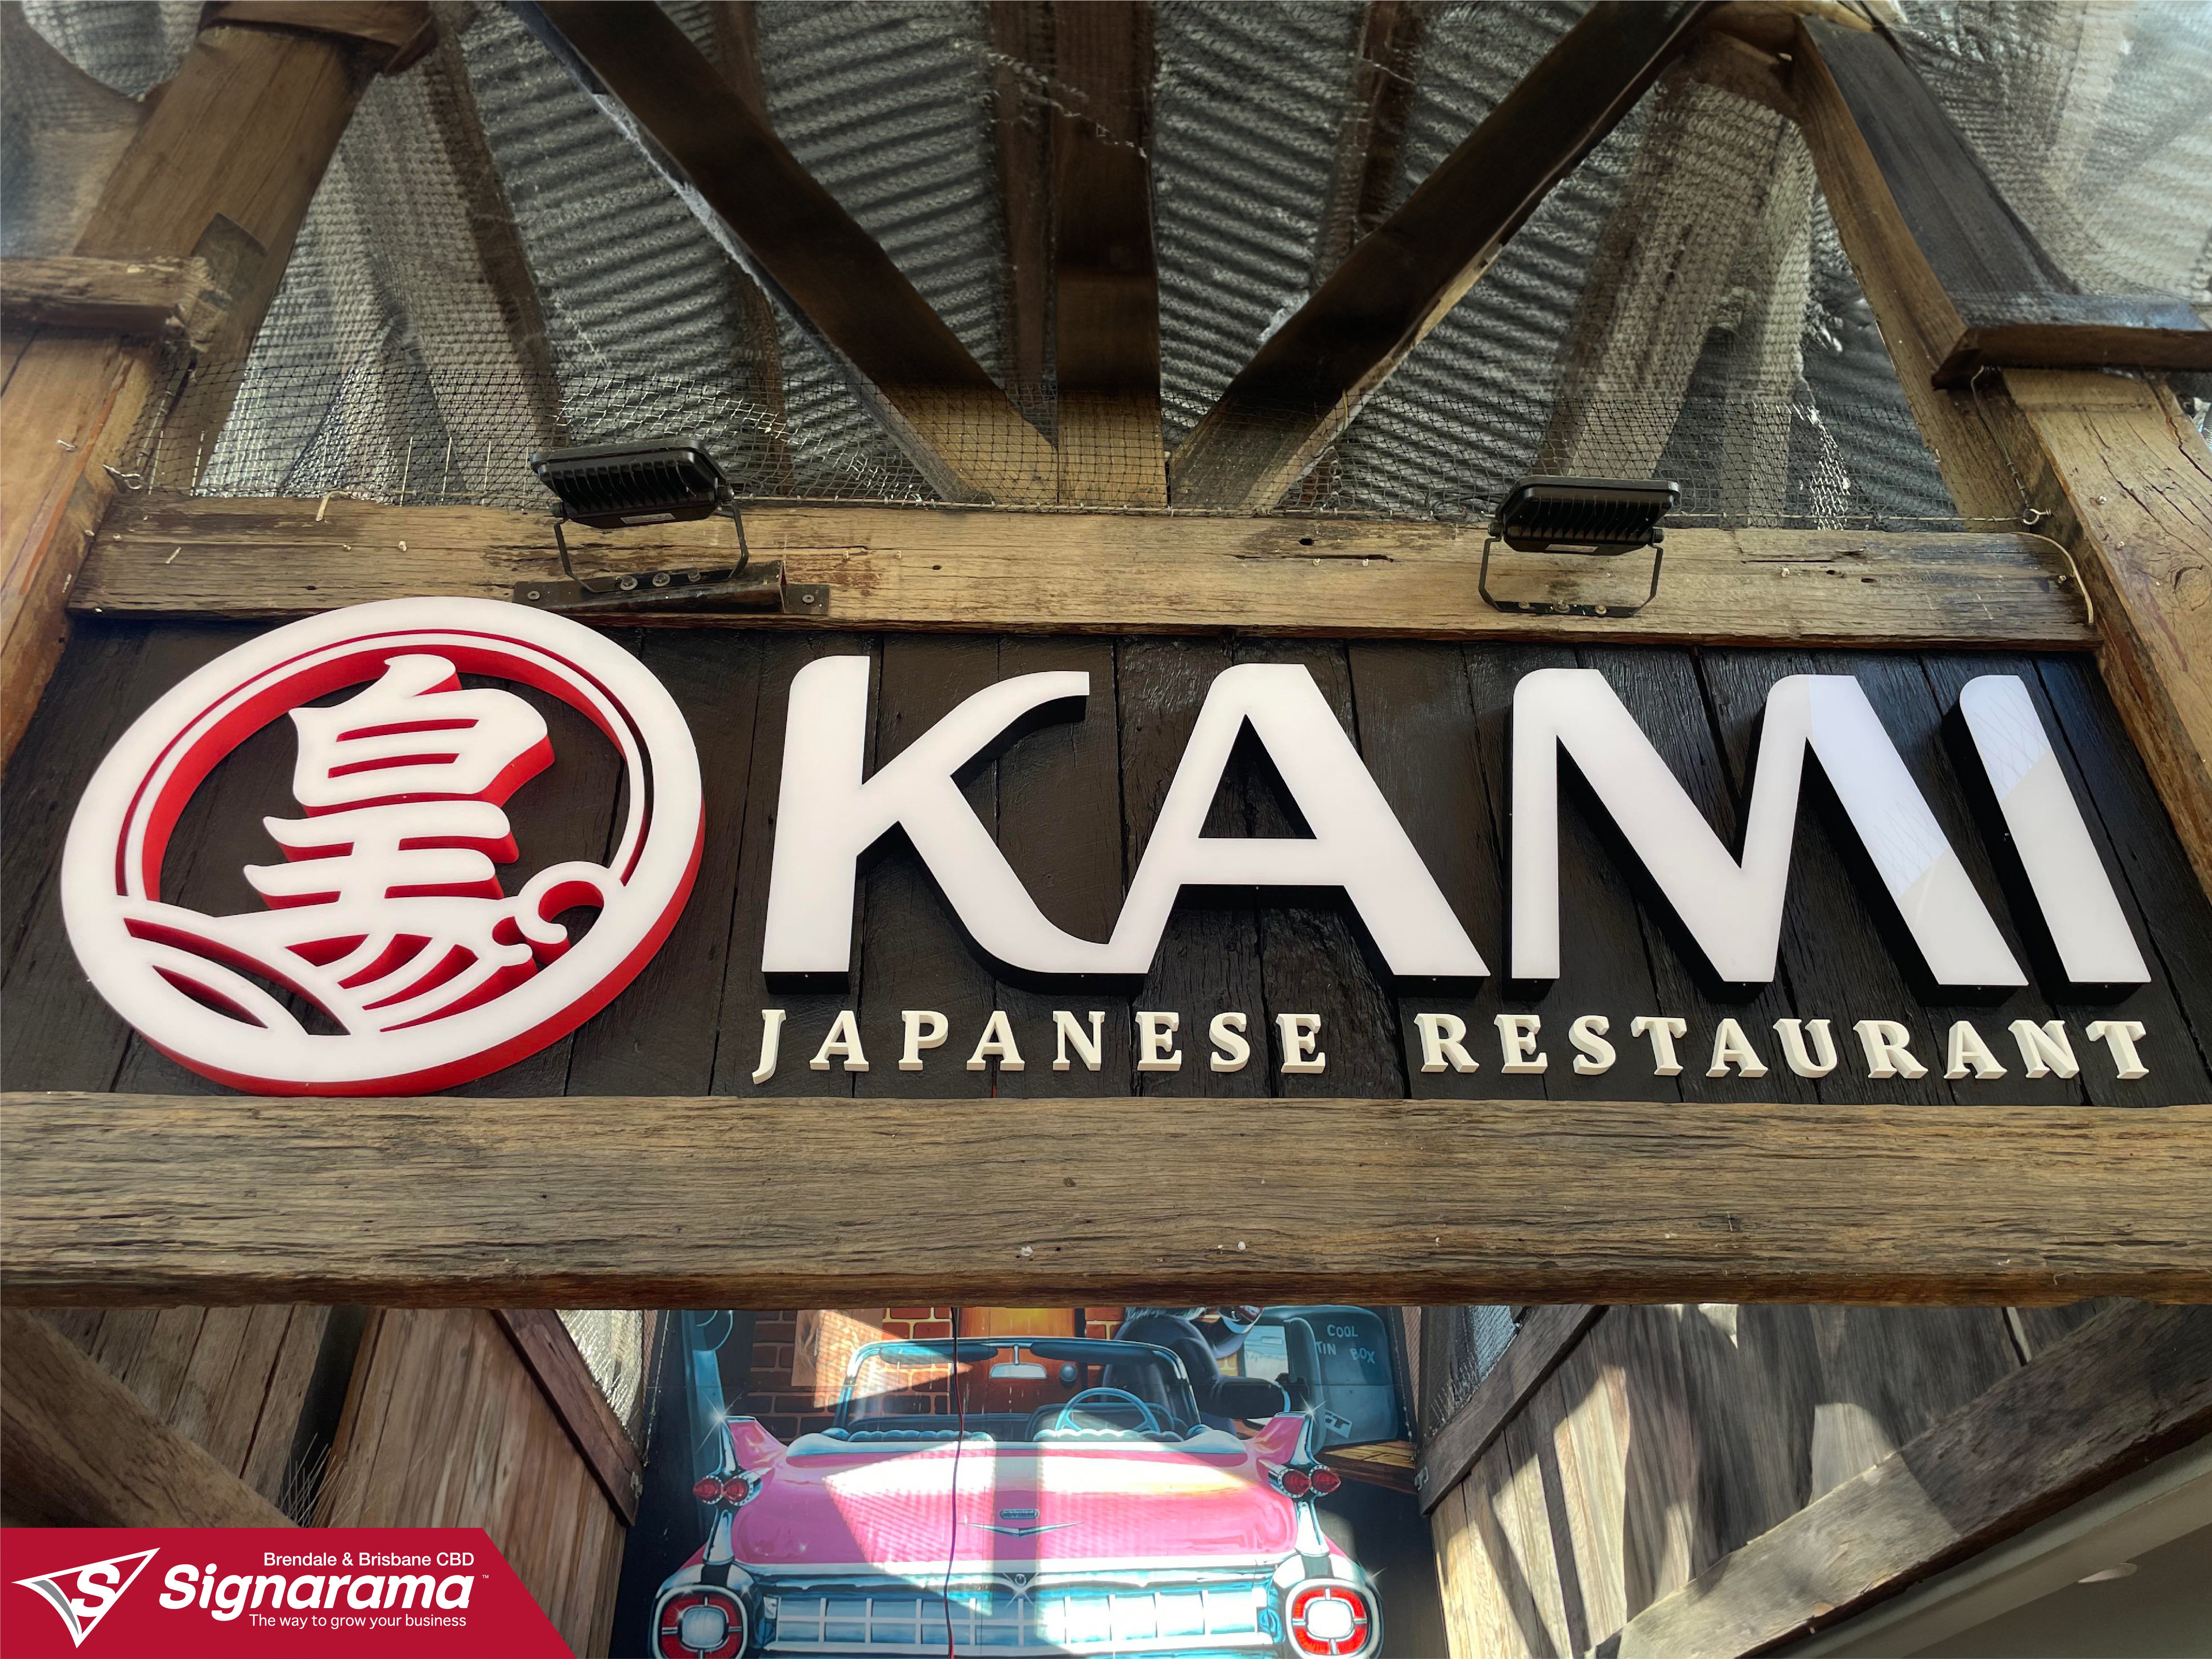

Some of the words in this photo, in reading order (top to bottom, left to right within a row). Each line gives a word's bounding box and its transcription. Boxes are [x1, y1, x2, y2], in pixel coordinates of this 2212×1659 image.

[762, 656, 2151, 985] KAMI
[752, 1009, 1326, 1084] JAPANESE
[1414, 1013, 2149, 1079] RESTAURANT
[1316, 1341, 1336, 1355] TIN
[1349, 1347, 1376, 1364] BOX
[1327, 1324, 1358, 1338] COOL
